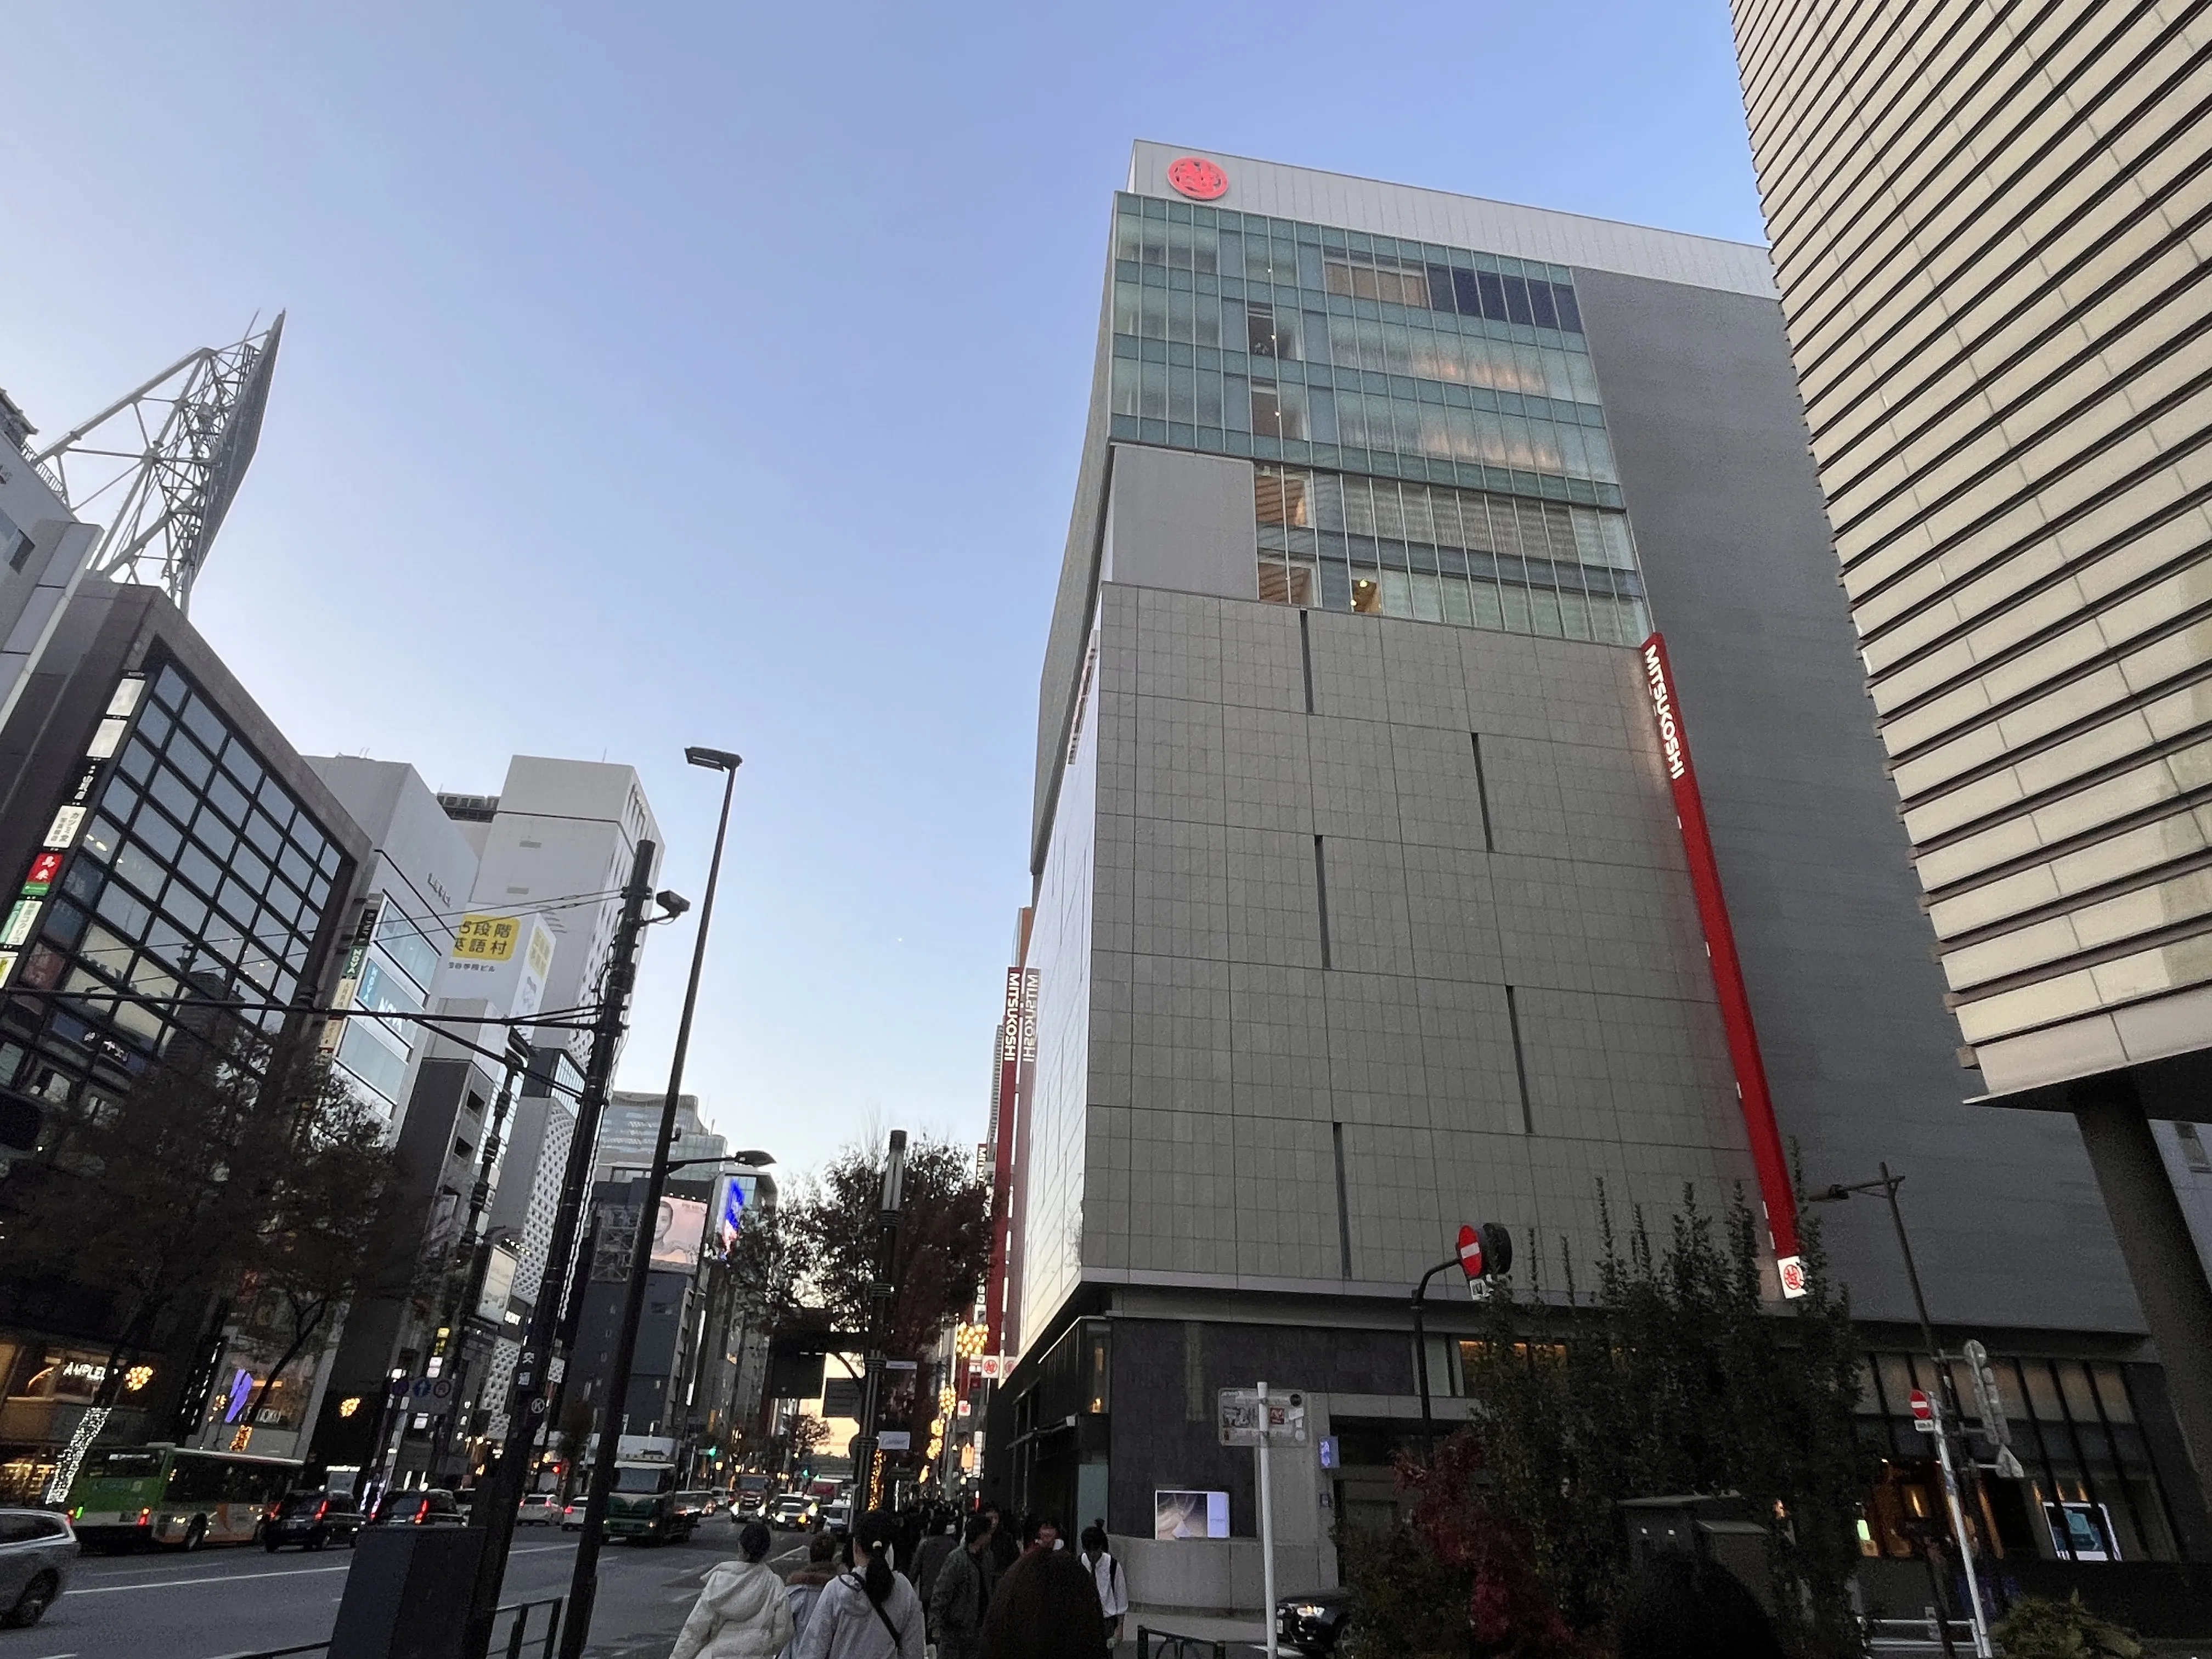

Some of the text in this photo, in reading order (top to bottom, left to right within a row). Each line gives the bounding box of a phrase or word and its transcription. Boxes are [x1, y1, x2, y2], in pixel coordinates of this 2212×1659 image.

[1645, 644, 1685, 780] MITSUKOSHI
[454, 937, 507, 955] 英語村
[459, 921, 512, 938] 5段階
[347, 949, 362, 973] NOVA
[363, 967, 378, 1003] NOVA
[1004, 973, 1020, 1061] MITSUKOSHI
[977, 1147, 986, 1189] MITSU
